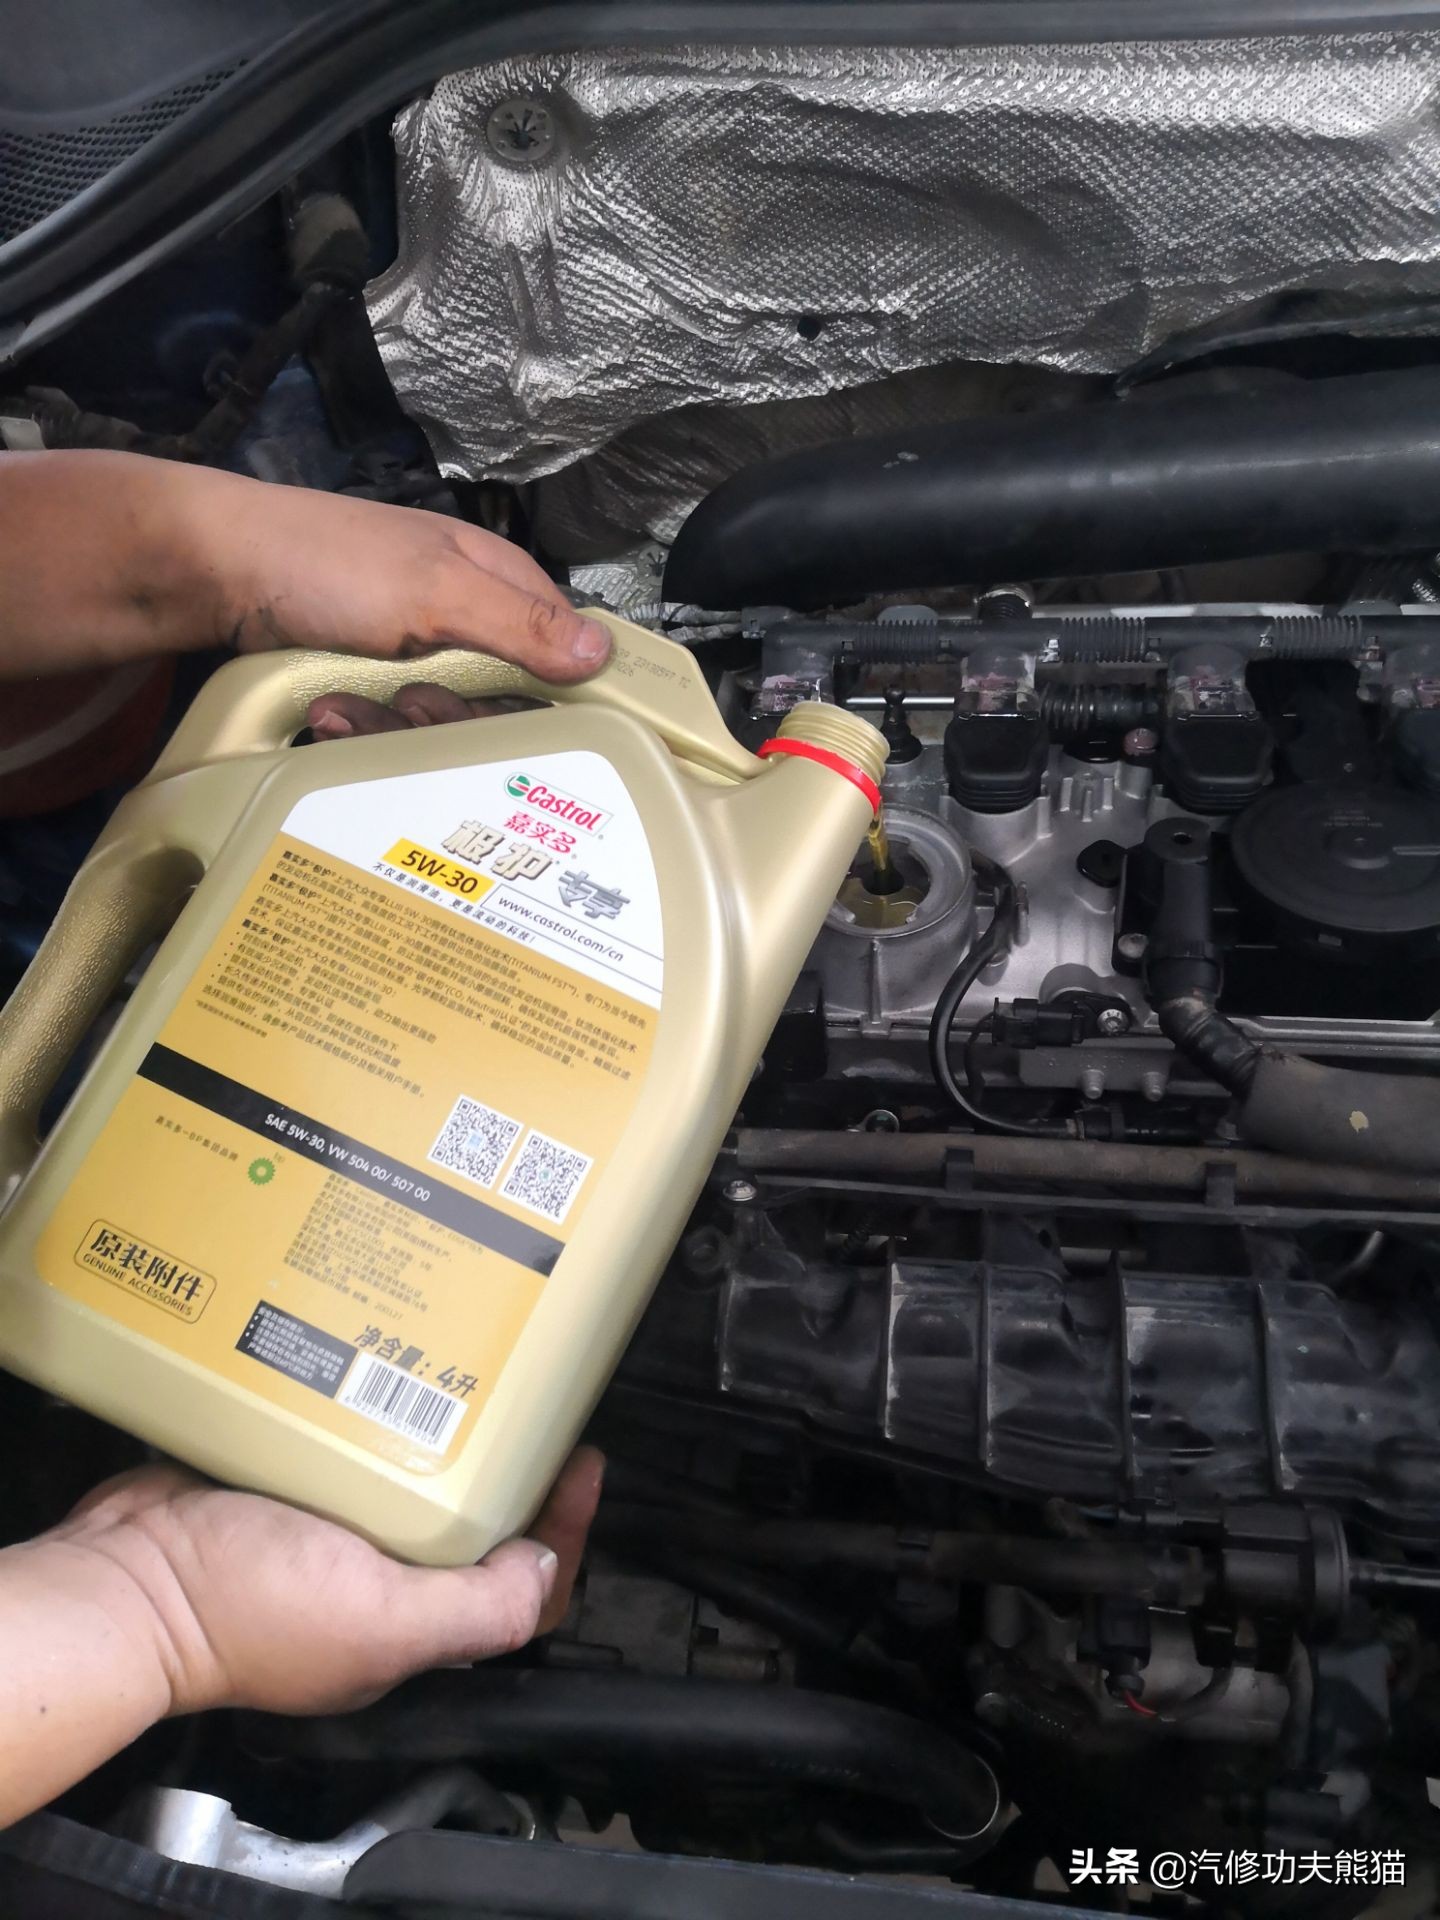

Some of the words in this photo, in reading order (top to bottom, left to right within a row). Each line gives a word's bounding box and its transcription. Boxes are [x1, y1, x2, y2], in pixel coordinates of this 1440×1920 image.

[504, 811, 576, 854] 嘉实多
[526, 786, 601, 829] Castrol
[401, 851, 478, 892] 5W-30
[441, 820, 553, 882] 极护
[499, 897, 623, 960] www.castrol.com/cn
[264, 1113, 287, 1131] SAE
[285, 1123, 328, 1153] 5W-30,
[326, 1143, 348, 1162] VW
[347, 1153, 371, 1173] 504
[369, 1164, 392, 1183] 00/
[390, 1174, 415, 1194] 507
[412, 1185, 431, 1202] 00
[81, 1252, 126, 1282] GENUINE
[126, 1276, 194, 1317] ACCESSORIES
[89, 1228, 206, 1304] 原装附件
